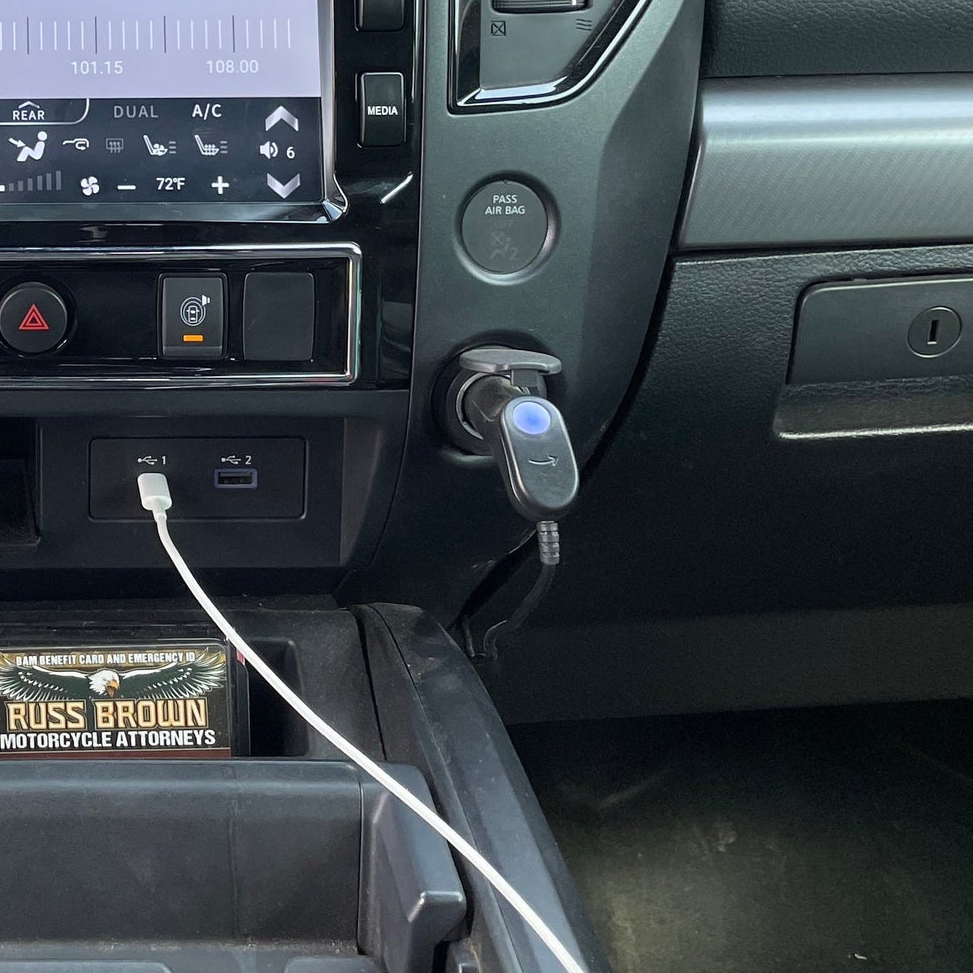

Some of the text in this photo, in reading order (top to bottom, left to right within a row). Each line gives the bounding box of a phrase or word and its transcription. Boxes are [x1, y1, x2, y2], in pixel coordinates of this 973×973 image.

[70, 60, 123, 75] 101.15
[206, 59, 260, 74] 108.00
[12, 109, 45, 121] REAR
[113, 105, 158, 119] DUAL
[192, 103, 222, 120] A/C
[367, 105, 399, 116] MEDIA
[286, 146, 295, 159] 6
[492, 194, 518, 204] PASS
[484, 205, 526, 215] AIR BAG
[160, 454, 167, 466] 1
[243, 454, 253, 465] 2
[39, 654, 77, 665] BENEFIT
[79, 653, 104, 664] CARD
[106, 653, 126, 664] AND
[128, 652, 184, 663] EMERGENCY
[185, 651, 196, 662] ID
[6, 698, 209, 731] RUSS BROWN
[0, 729, 216, 750] MOTORCYCLE ATTORNEYS
